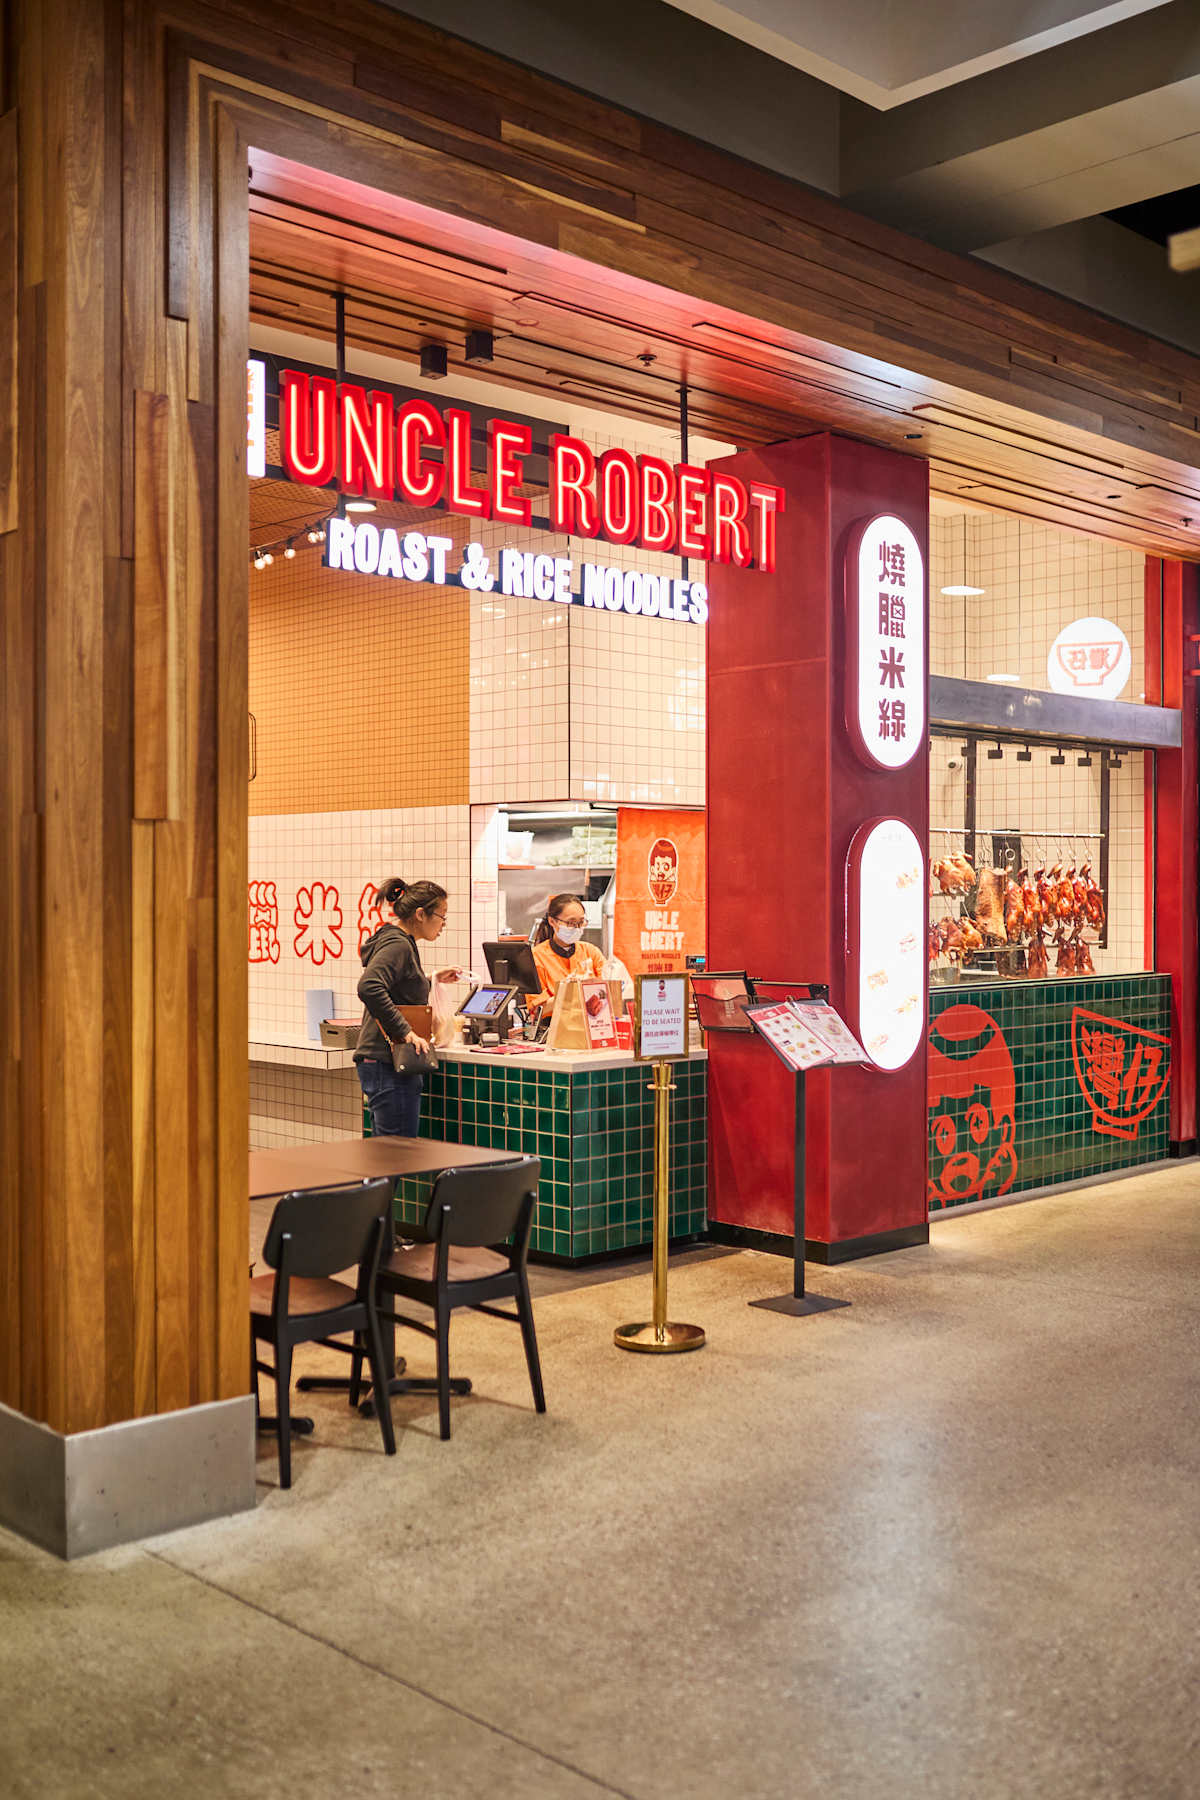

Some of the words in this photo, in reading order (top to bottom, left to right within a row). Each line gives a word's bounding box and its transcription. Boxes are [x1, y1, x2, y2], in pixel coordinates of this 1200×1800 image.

[279, 368, 532, 527] UNCLE
[550, 432, 786, 574] ROBERT
[328, 517, 453, 585] ROAST
[460, 542, 495, 592] &
[501, 548, 574, 605] RICE
[583, 562, 709, 625] NOODLES
[878, 540, 906, 742] 燒臘米線
[664, 1008, 680, 1016] WAIT
